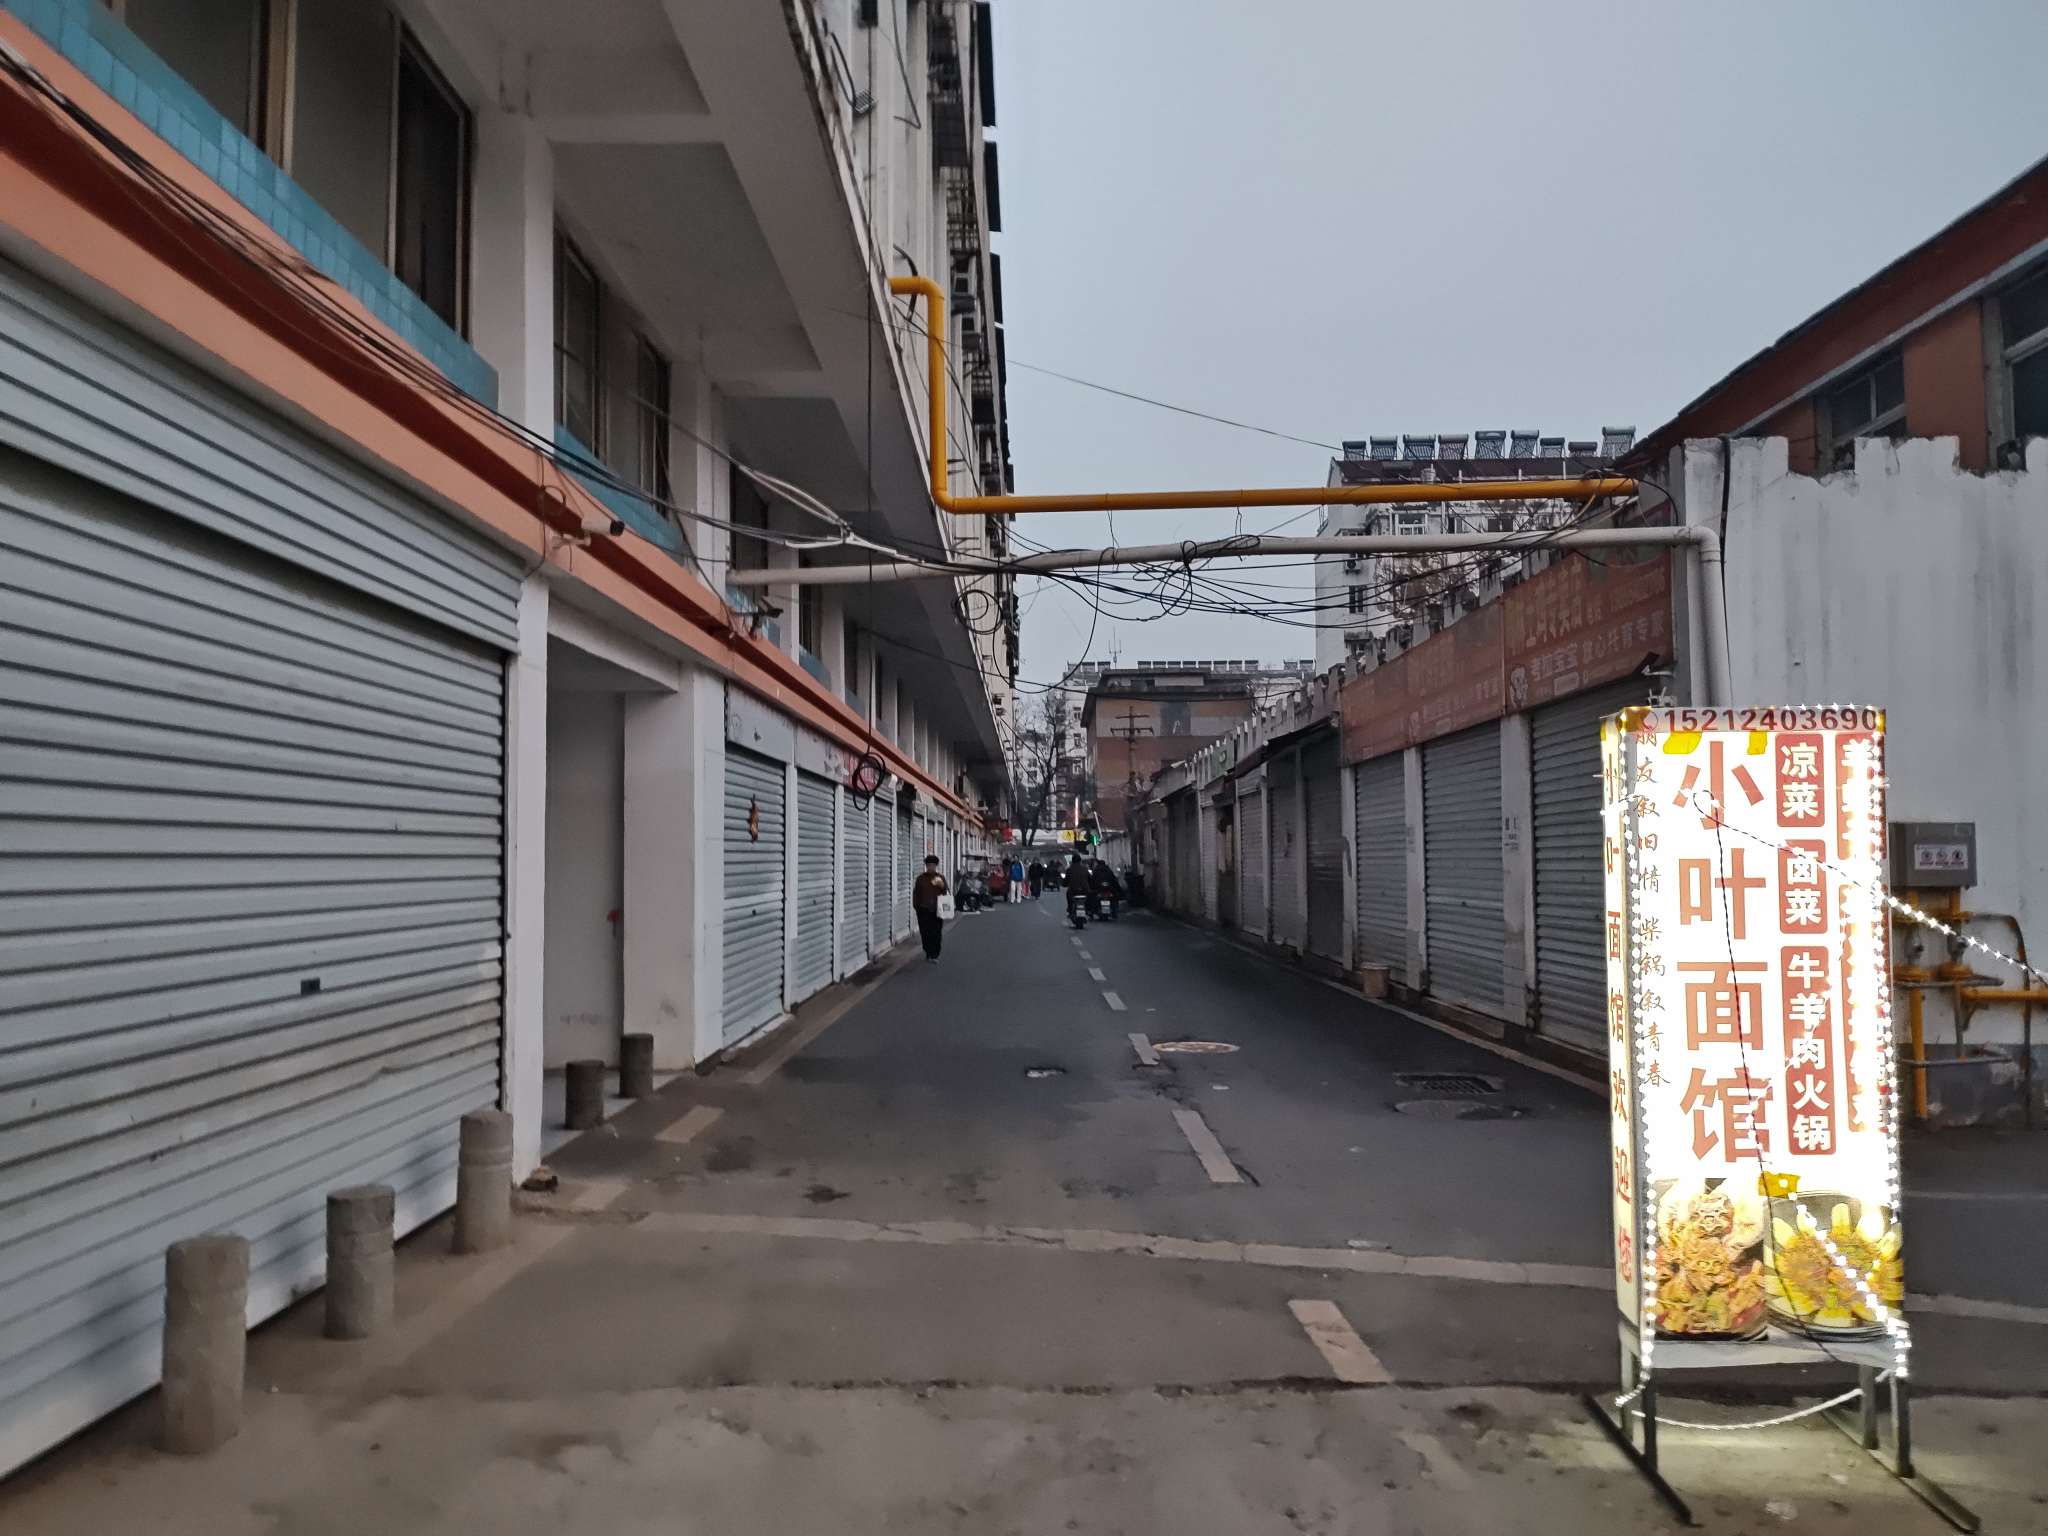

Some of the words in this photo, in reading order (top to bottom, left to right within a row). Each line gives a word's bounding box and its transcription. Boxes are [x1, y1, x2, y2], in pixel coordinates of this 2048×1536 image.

[1664, 708, 1878, 732] 15212403690
[1780, 742, 1819, 819] 凉菜
[1784, 846, 1823, 926] 卤菜
[1672, 741, 1774, 1163] 小叶面馆
[1786, 951, 1832, 1151] 牛羊肉火锅
